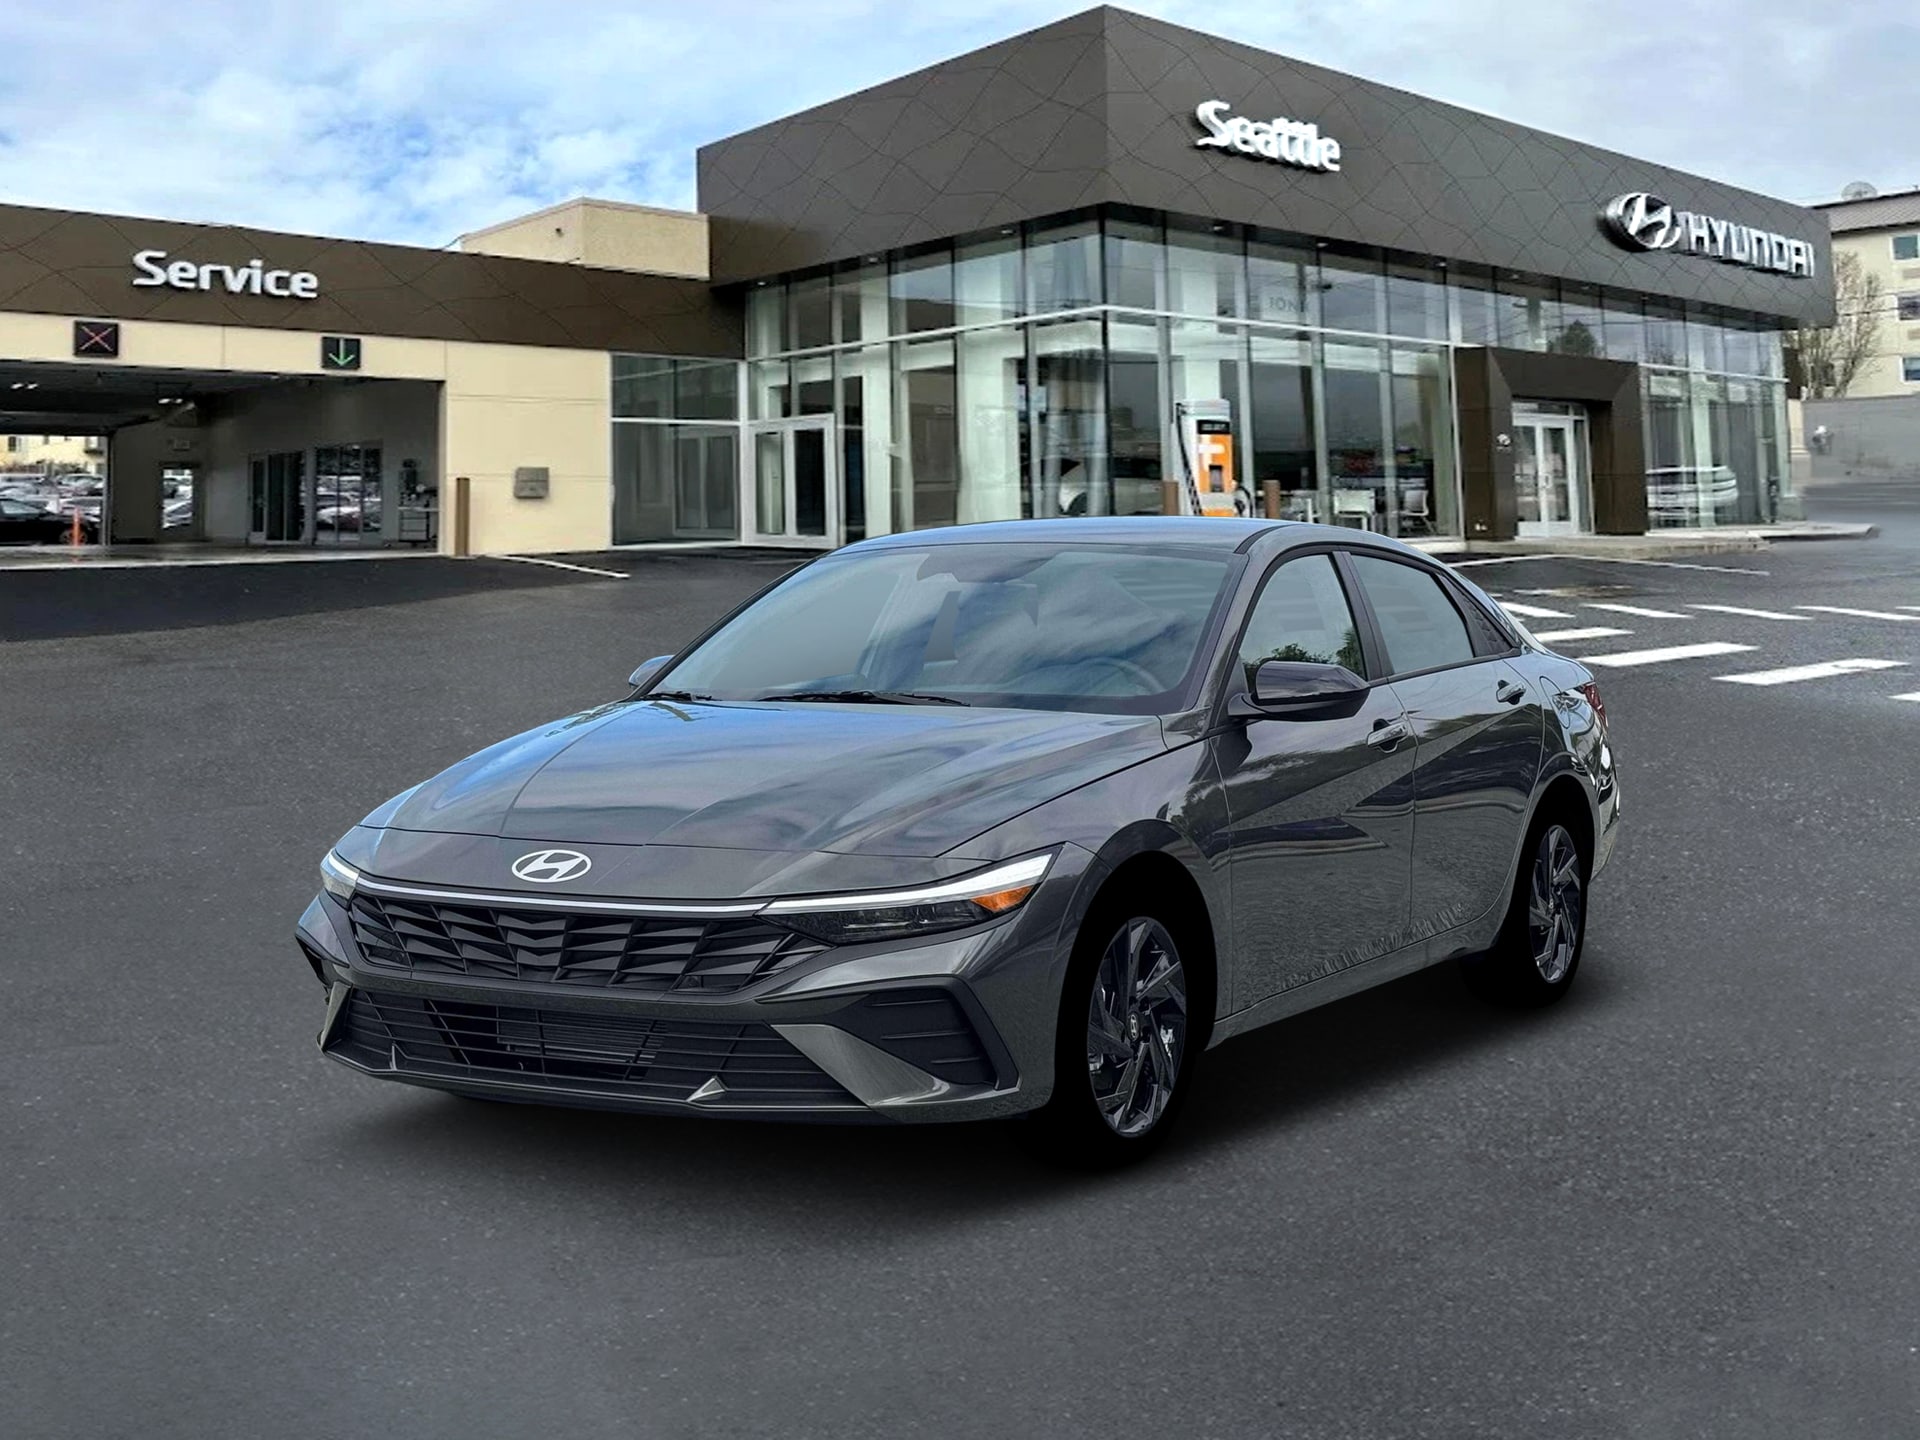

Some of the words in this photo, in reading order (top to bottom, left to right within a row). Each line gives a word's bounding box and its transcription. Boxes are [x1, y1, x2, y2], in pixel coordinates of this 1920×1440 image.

[1196, 100, 1341, 171] Seattle
[132, 250, 319, 298] Service
[1676, 211, 1815, 277] HYUNDAI
